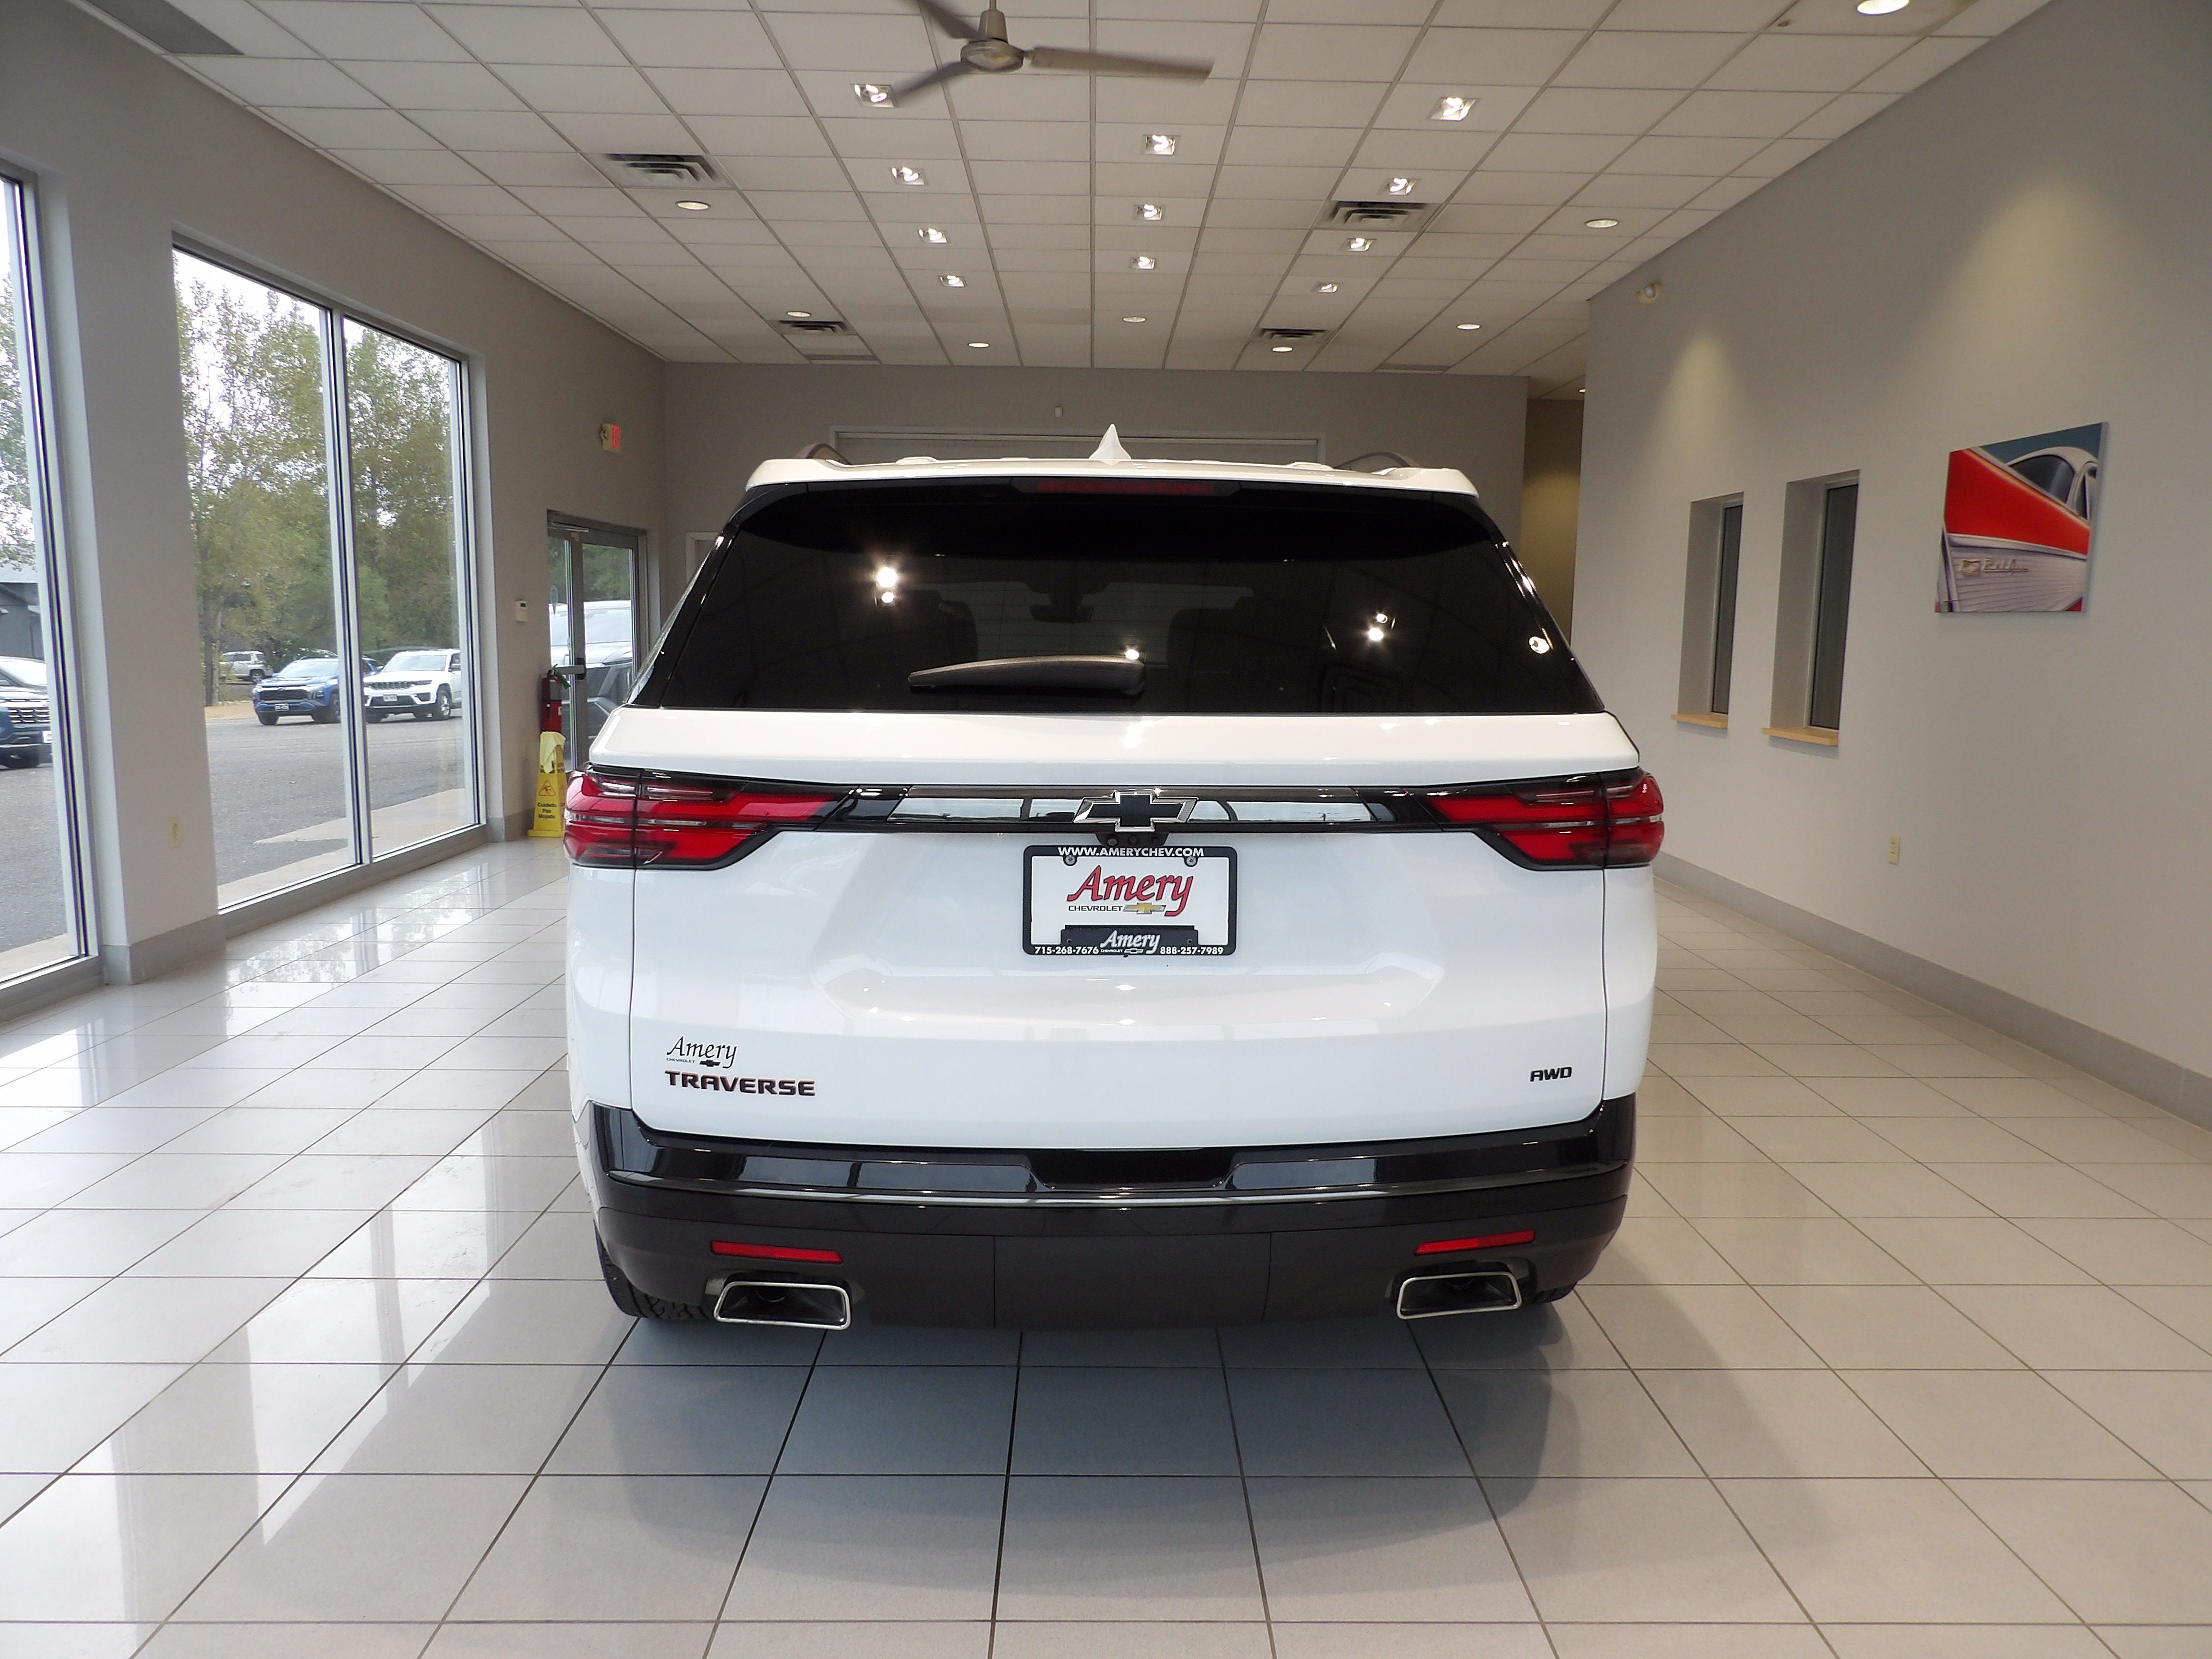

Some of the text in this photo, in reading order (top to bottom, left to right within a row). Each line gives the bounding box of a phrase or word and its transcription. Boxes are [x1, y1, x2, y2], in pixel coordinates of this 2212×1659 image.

[1058, 847, 1204, 856] WWW.AMERYCHEV.COM
[1067, 865, 1194, 916] Amery
[1034, 946, 1099, 954] 715-268-7676
[1099, 930, 1161, 954] Amery
[1160, 947, 1224, 955] 888-257-7989
[666, 1036, 737, 1069] Amery
[664, 1070, 816, 1096] TRAVERSE
[1529, 1066, 1572, 1082] AWD
